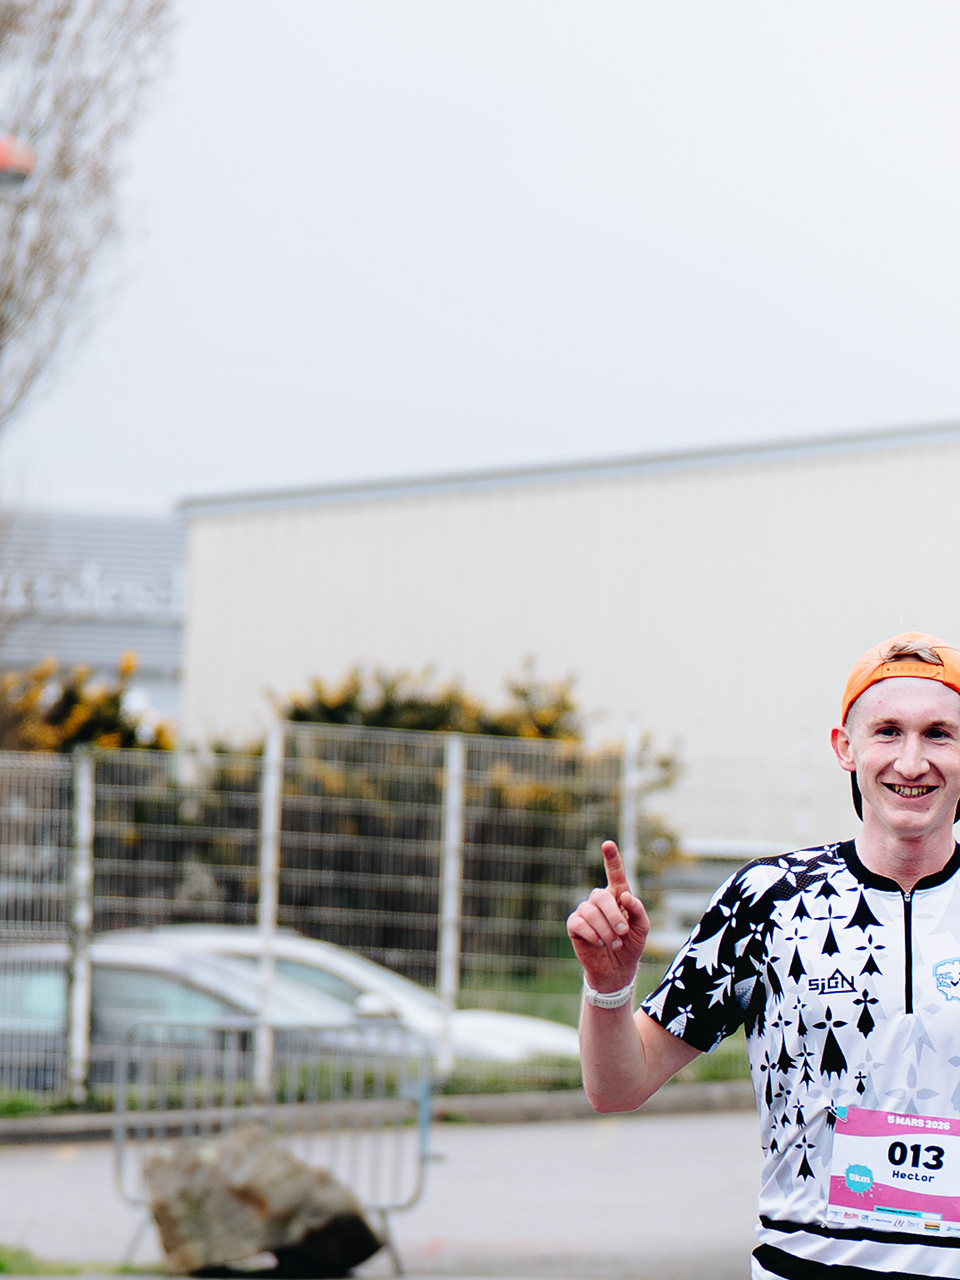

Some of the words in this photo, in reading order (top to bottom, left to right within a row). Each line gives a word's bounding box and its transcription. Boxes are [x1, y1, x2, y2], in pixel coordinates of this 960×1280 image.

[887, 1115, 895, 1124] 5
[896, 1116, 925, 1128] MARS
[925, 1120, 951, 1131] 2026
[888, 1141, 945, 1170] 013
[849, 1172, 871, 1184] 5km
[892, 1170, 935, 1182] Hector
